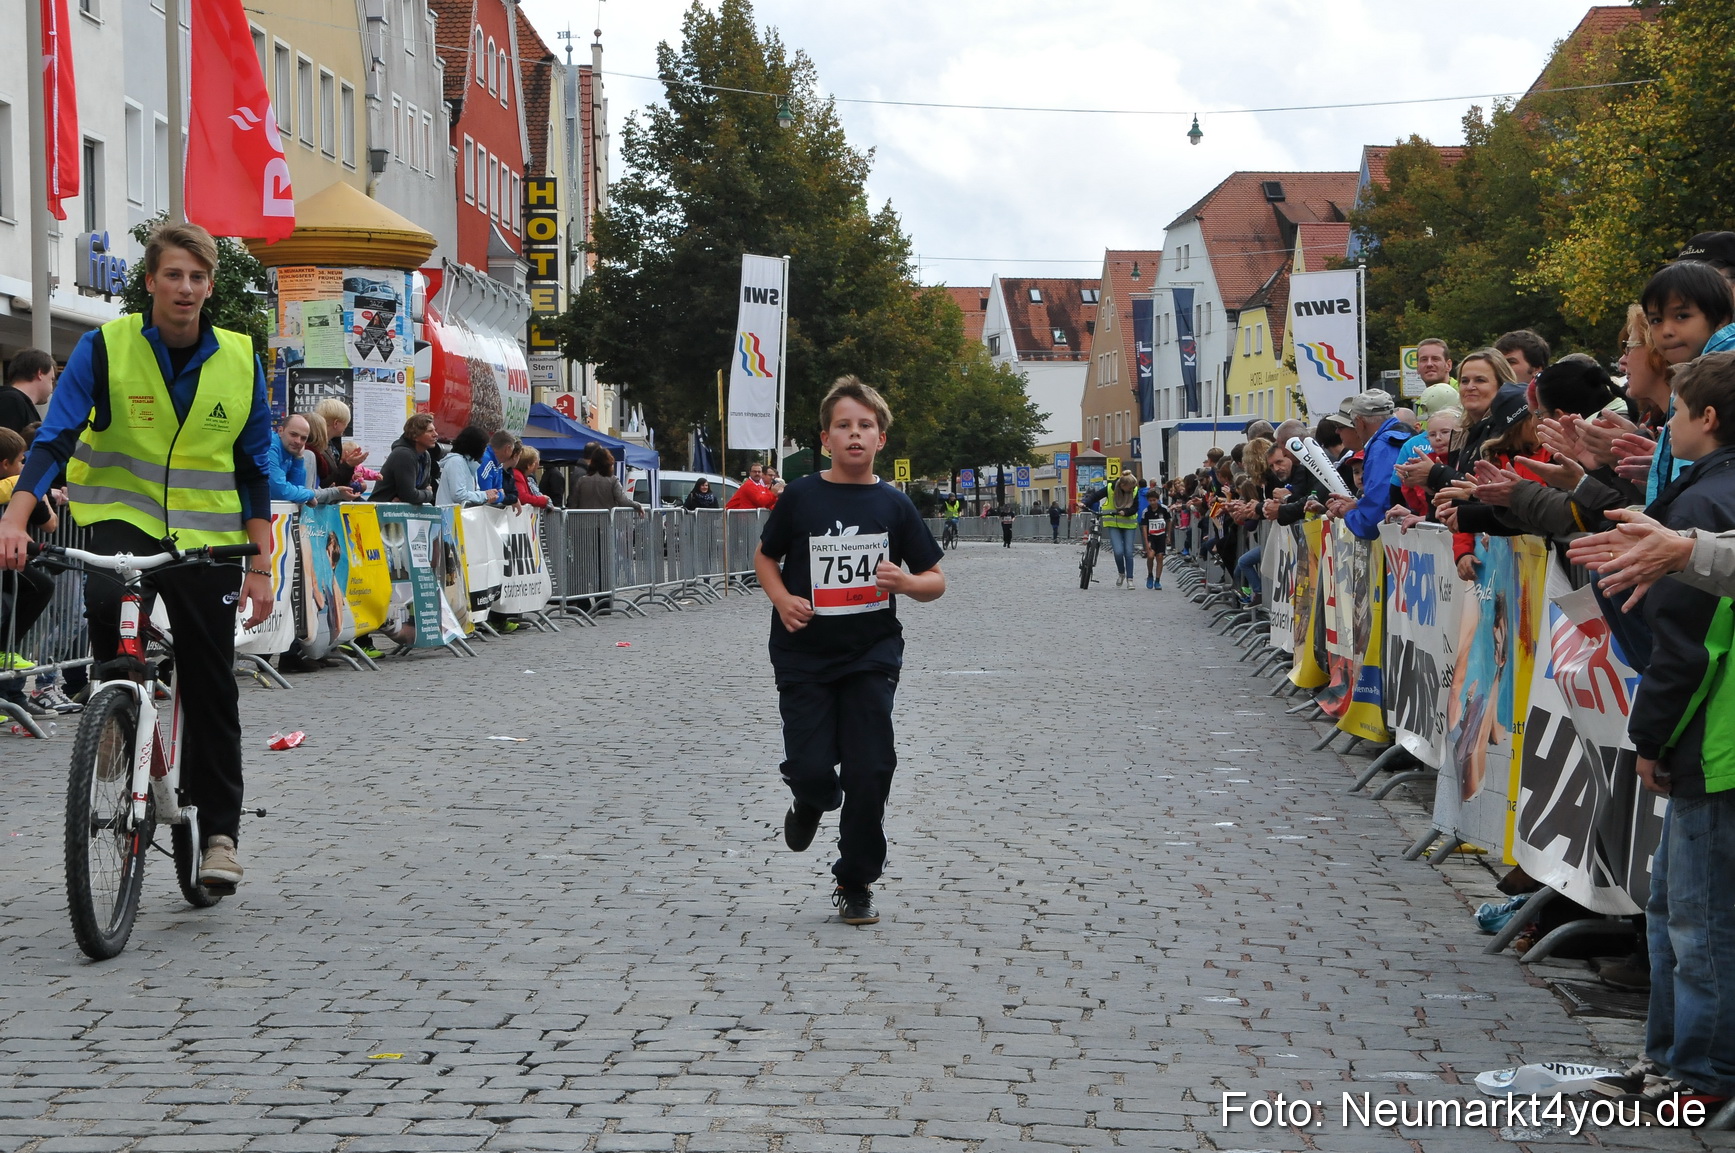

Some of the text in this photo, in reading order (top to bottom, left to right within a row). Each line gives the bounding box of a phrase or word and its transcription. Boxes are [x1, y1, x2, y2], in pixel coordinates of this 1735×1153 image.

[89, 231, 128, 295] fries
[527, 181, 557, 347] HOTEL
[532, 363, 554, 371] Stern
[508, 368, 529, 395] AVIA
[1250, 372, 1263, 386] HOTEL
[294, 383, 346, 395] GLENN
[899, 466, 906, 477] D
[1110, 465, 1118, 475] D
[811, 542, 881, 552] PARTL Neumarkt
[845, 591, 863, 601] Leo
